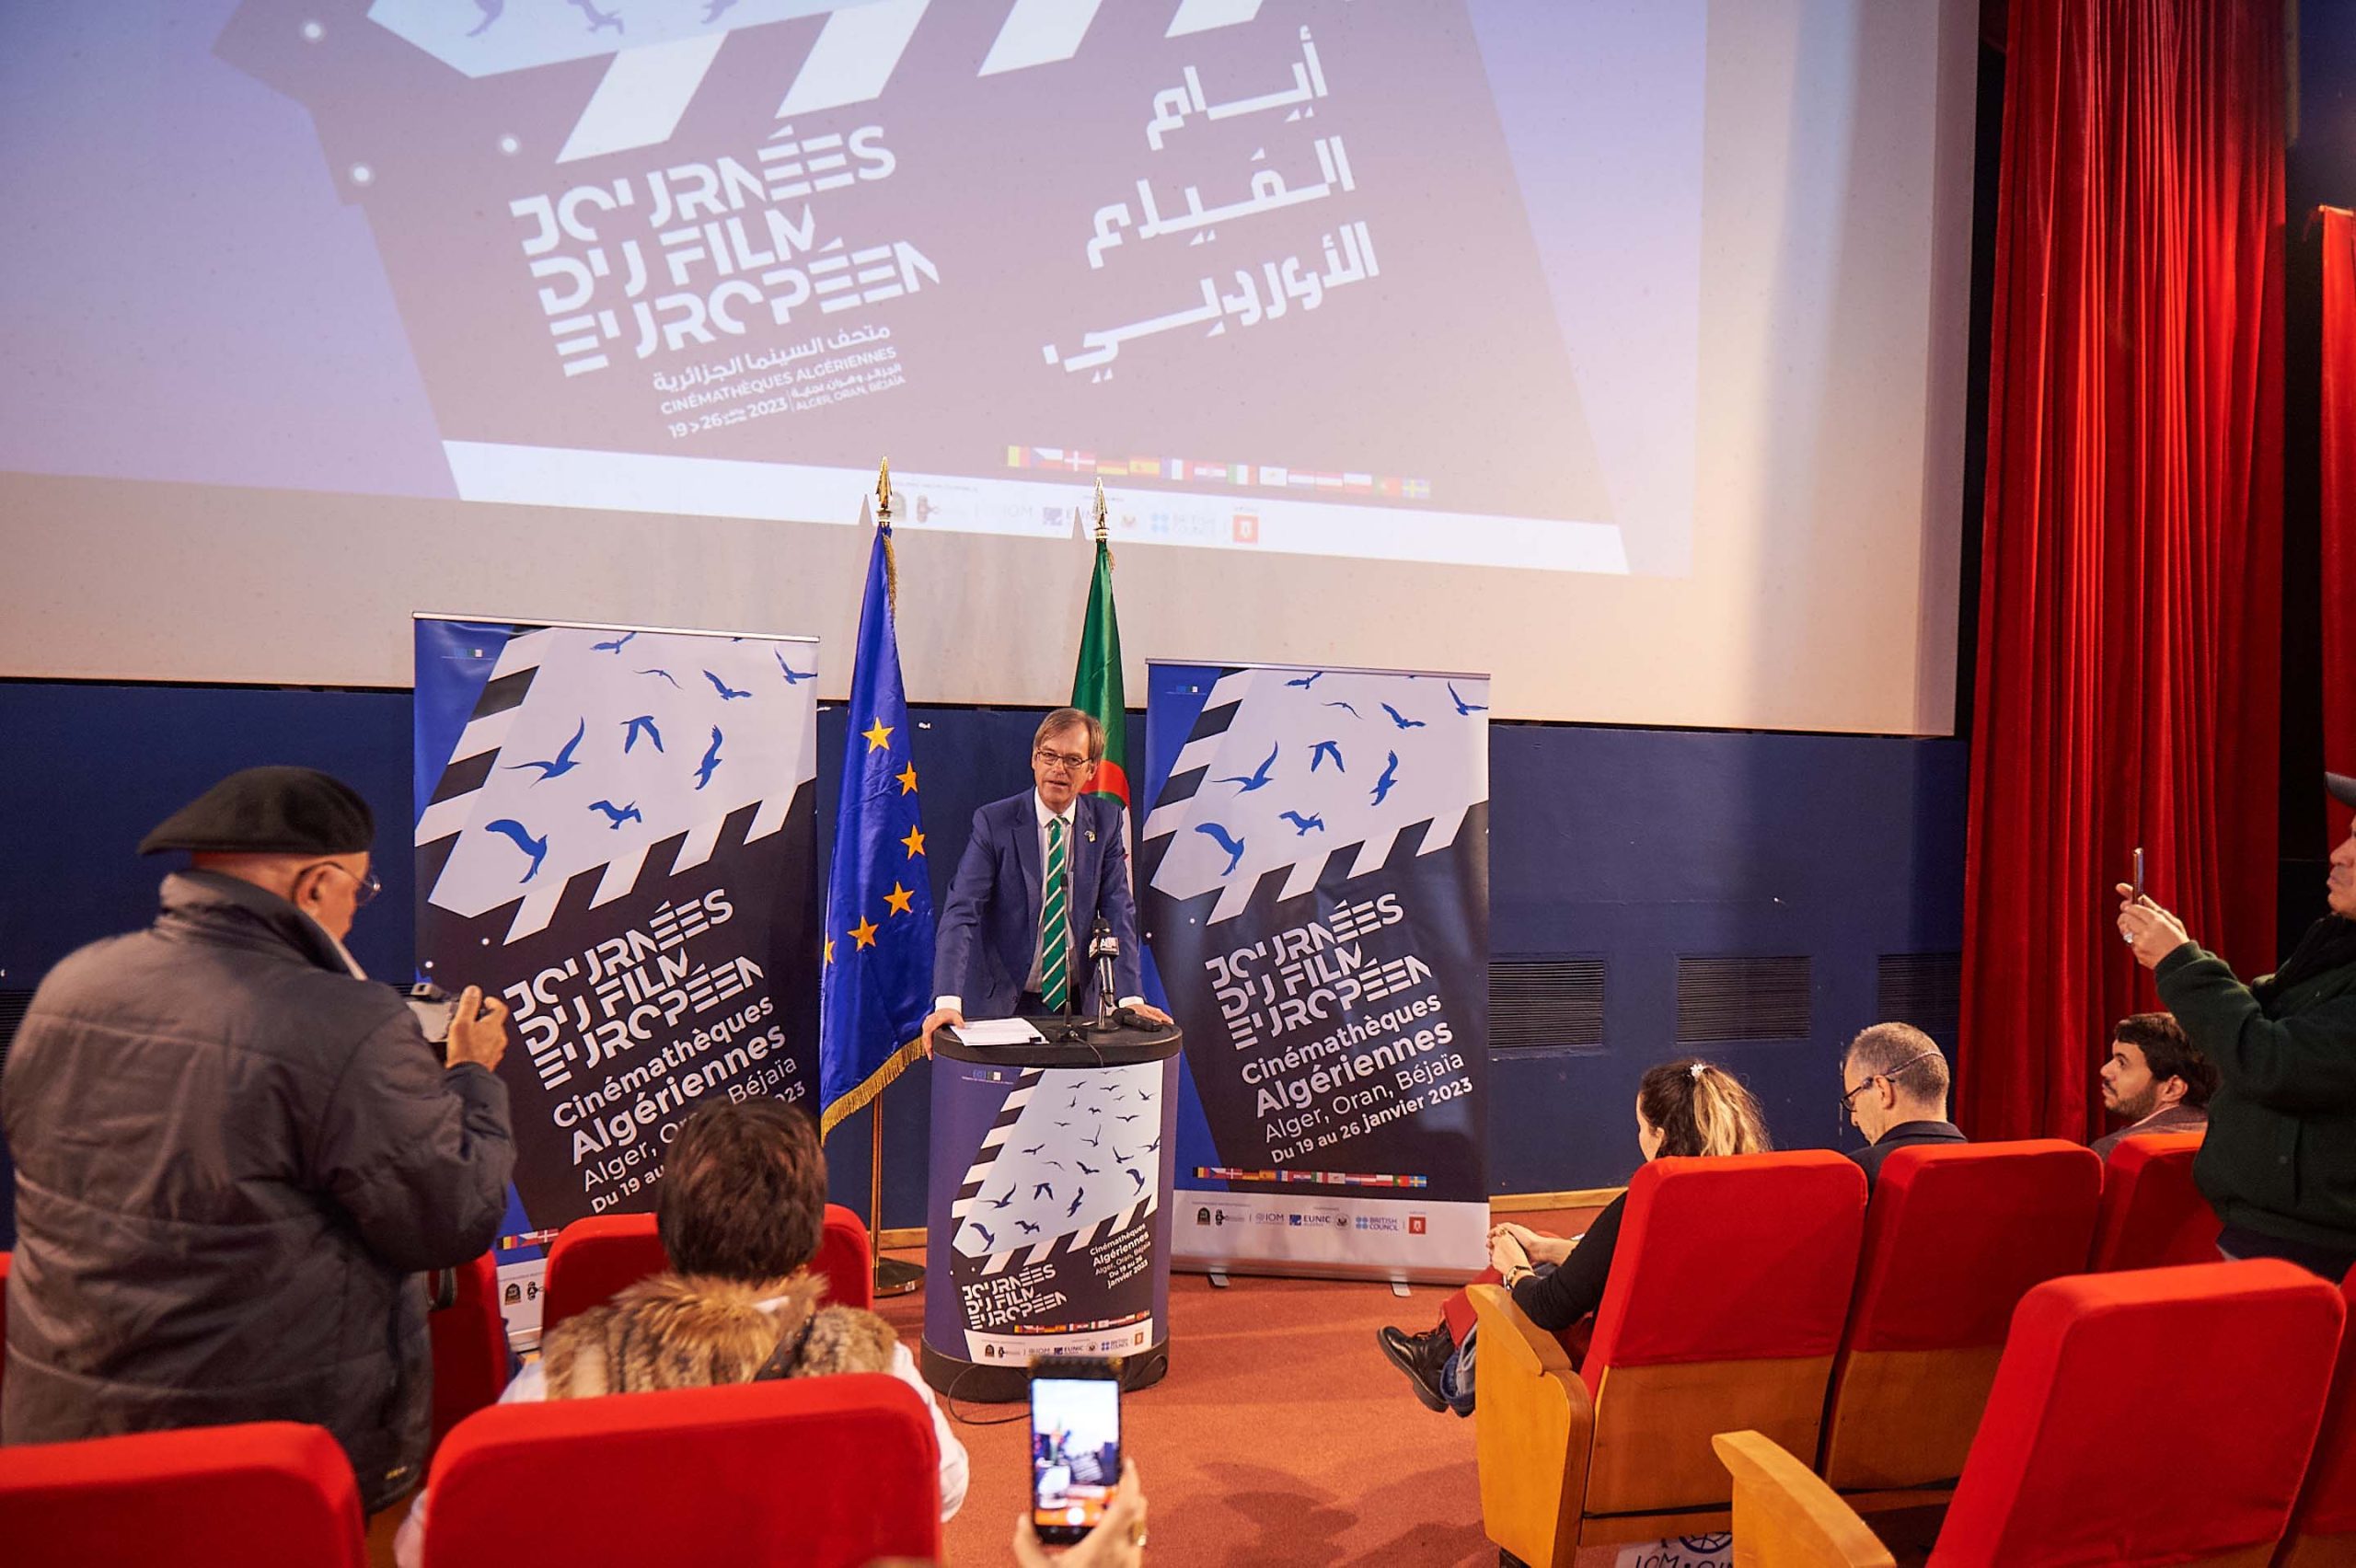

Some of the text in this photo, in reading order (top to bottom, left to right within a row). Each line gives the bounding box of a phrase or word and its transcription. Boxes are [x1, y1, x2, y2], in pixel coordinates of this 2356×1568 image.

[1147, 24, 1328, 151] أيام
[509, 124, 896, 255] JOURNÉES
[1087, 135, 1356, 270] الفيلم
[530, 203, 815, 315] DU FILM
[1043, 221, 1380, 384] الأوروبي
[550, 236, 940, 376] EUROPÉEN
[653, 324, 891, 392] متحف السينما الجزائرية
[661, 346, 896, 414] CINÉMATHÈQUES ALGÉRIENNES
[668, 421, 688, 439] 19
[699, 412, 722, 430] 26
[746, 397, 789, 419] 2023
[502, 888, 733, 1021] JOURNÉES
[1205, 893, 1404, 990] JOURNÉES
[1216, 941, 1363, 1020] DU FILM
[518, 946, 689, 1056] DU FILM
[534, 955, 764, 1090] EUROPÉEN
[1227, 954, 1432, 1051] EUROPÉEN
[1242, 994, 1442, 1085] Cinémathèques
[553, 996, 774, 1127] Cinémathèques
[572, 1024, 786, 1166] Algériennes
[1256, 1021, 1454, 1119] Algériennes
[1265, 1052, 1465, 1144] Alger, Oran, Béjaïa
[584, 1057, 798, 1193] Alger, Béjaïa
[1271, 1076, 1473, 1164] Du 19 au 26 janvier 2023
[590, 1192, 619, 1214] Du
[619, 1177, 641, 1196] 19
[1265, 1213, 1285, 1222] IOM
[1303, 1215, 1331, 1223] EUNIC
[1369, 1223, 1399, 1231] COUNCIL
[962, 1263, 1057, 1300] JOURNÉES
[1093, 1231, 1149, 1267] Algériennes
[1108, 1270, 1132, 1289] janvier
[965, 1286, 1034, 1315] DU FILM
[969, 1291, 1067, 1330] EUROPÉEN
